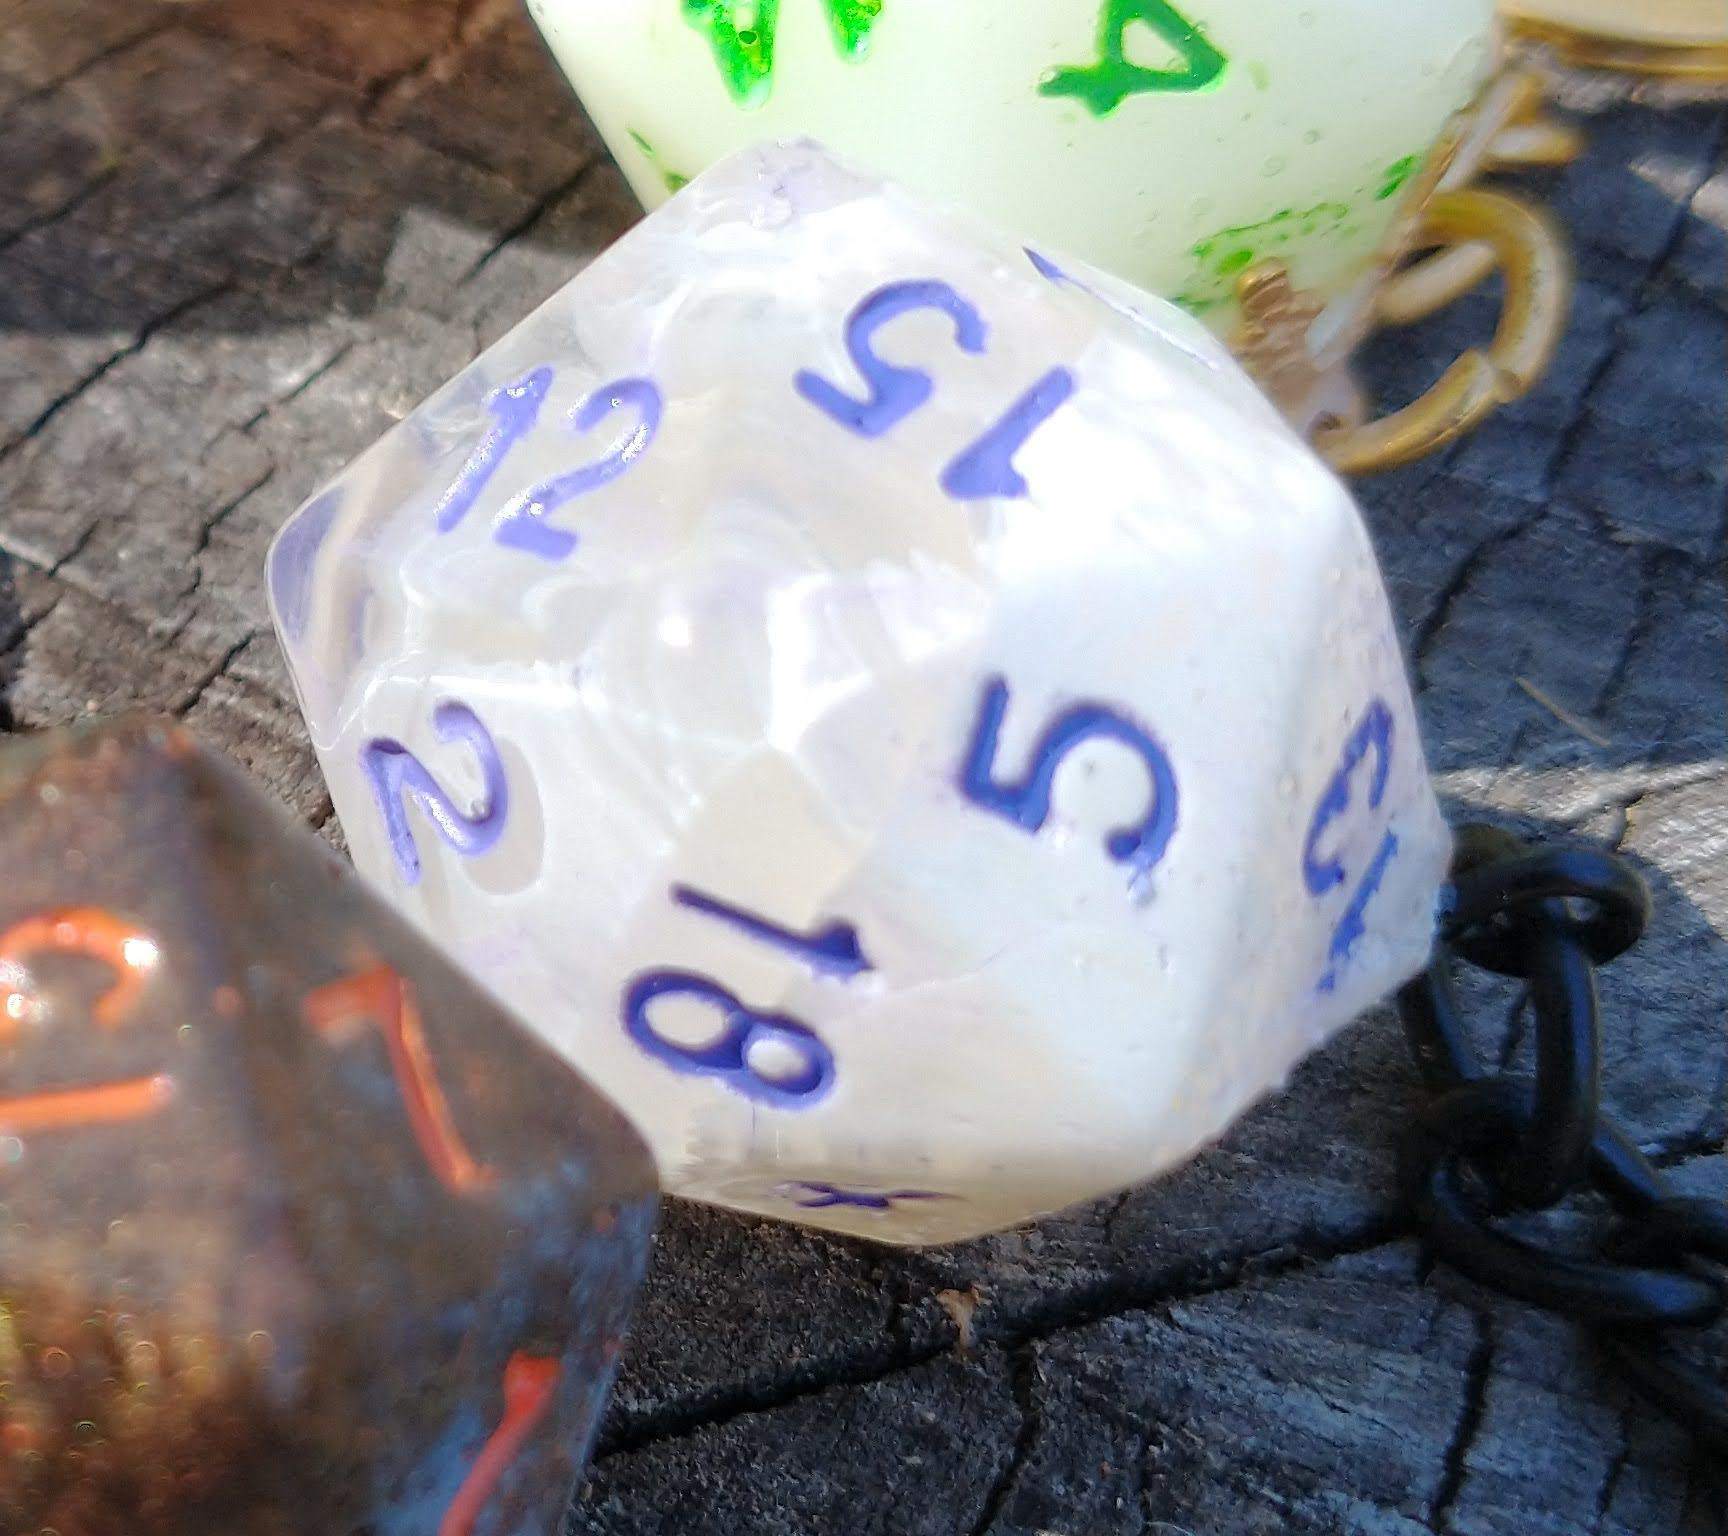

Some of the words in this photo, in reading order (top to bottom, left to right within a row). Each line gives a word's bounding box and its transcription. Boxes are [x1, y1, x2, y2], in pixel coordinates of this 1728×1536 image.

[435, 367, 663, 562] 12
[793, 278, 1081, 504] 15
[359, 699, 511, 886] 2
[957, 673, 1179, 872] 5
[619, 882, 875, 1112] 18
